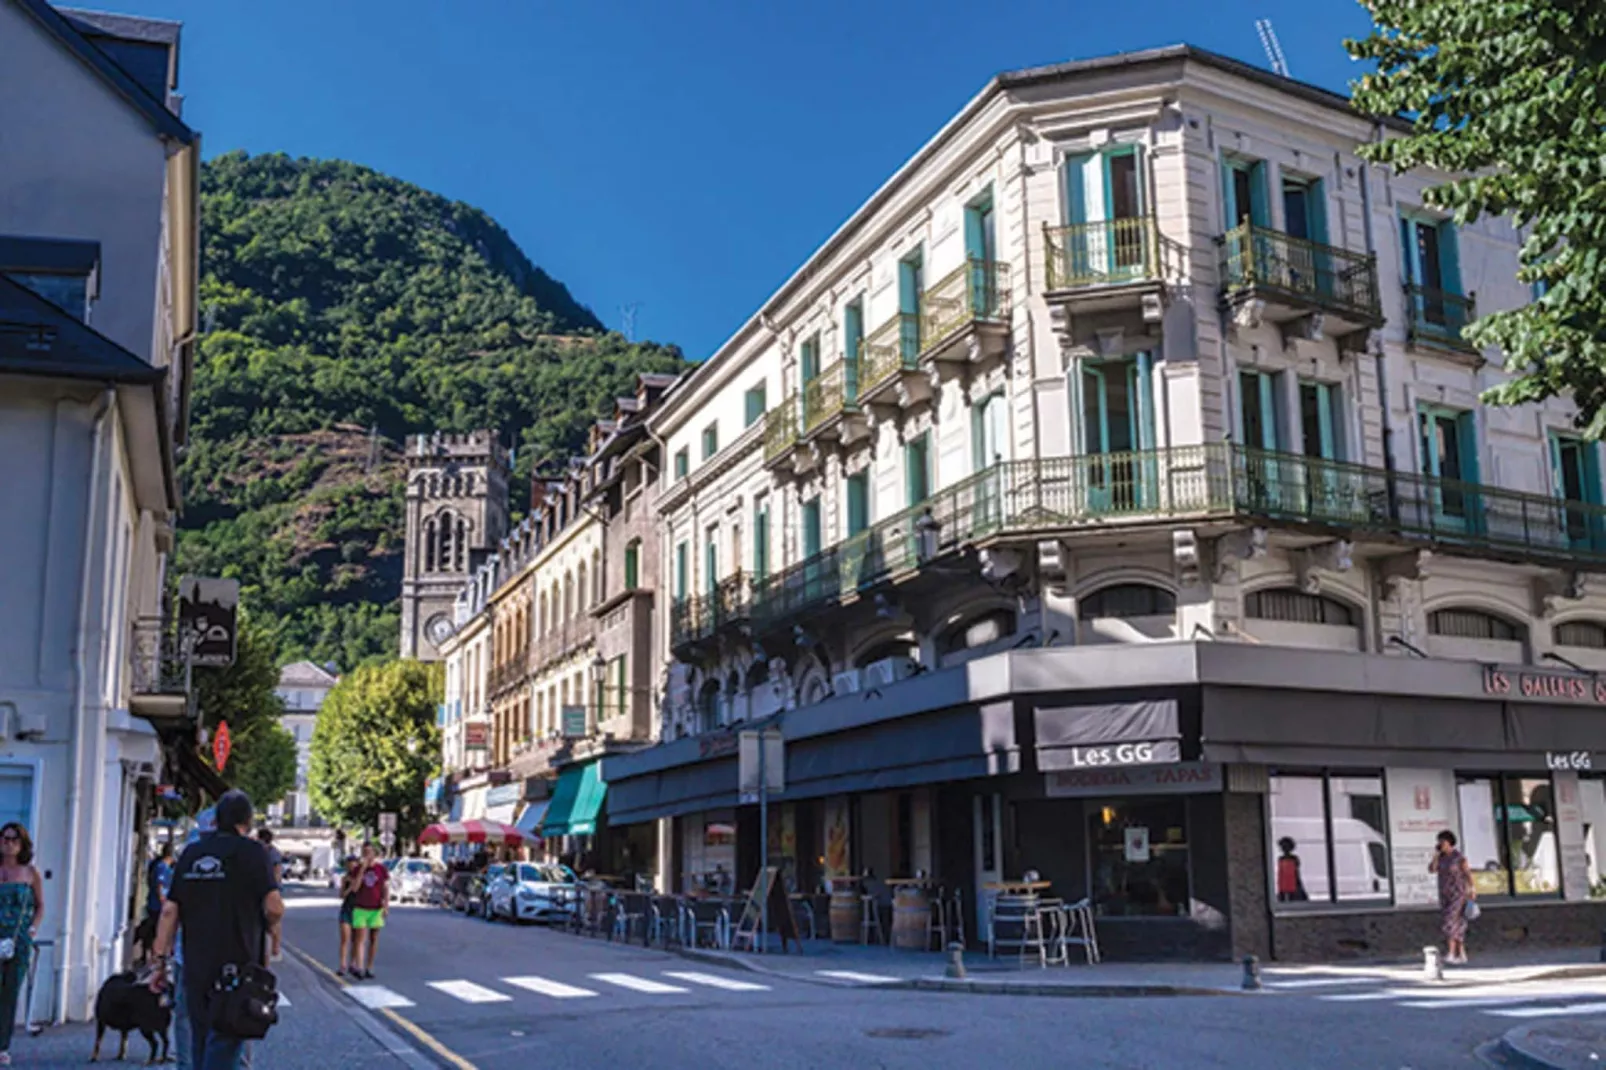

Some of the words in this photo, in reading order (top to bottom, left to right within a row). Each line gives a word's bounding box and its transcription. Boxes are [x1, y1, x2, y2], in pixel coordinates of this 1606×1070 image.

[1483, 665, 1511, 694] LES
[1072, 747, 1111, 767] Les
[1115, 742, 1153, 764] GG
[1545, 751, 1570, 770] Les
[1570, 751, 1592, 770] GG
[1151, 767, 1212, 784] TAPAS
